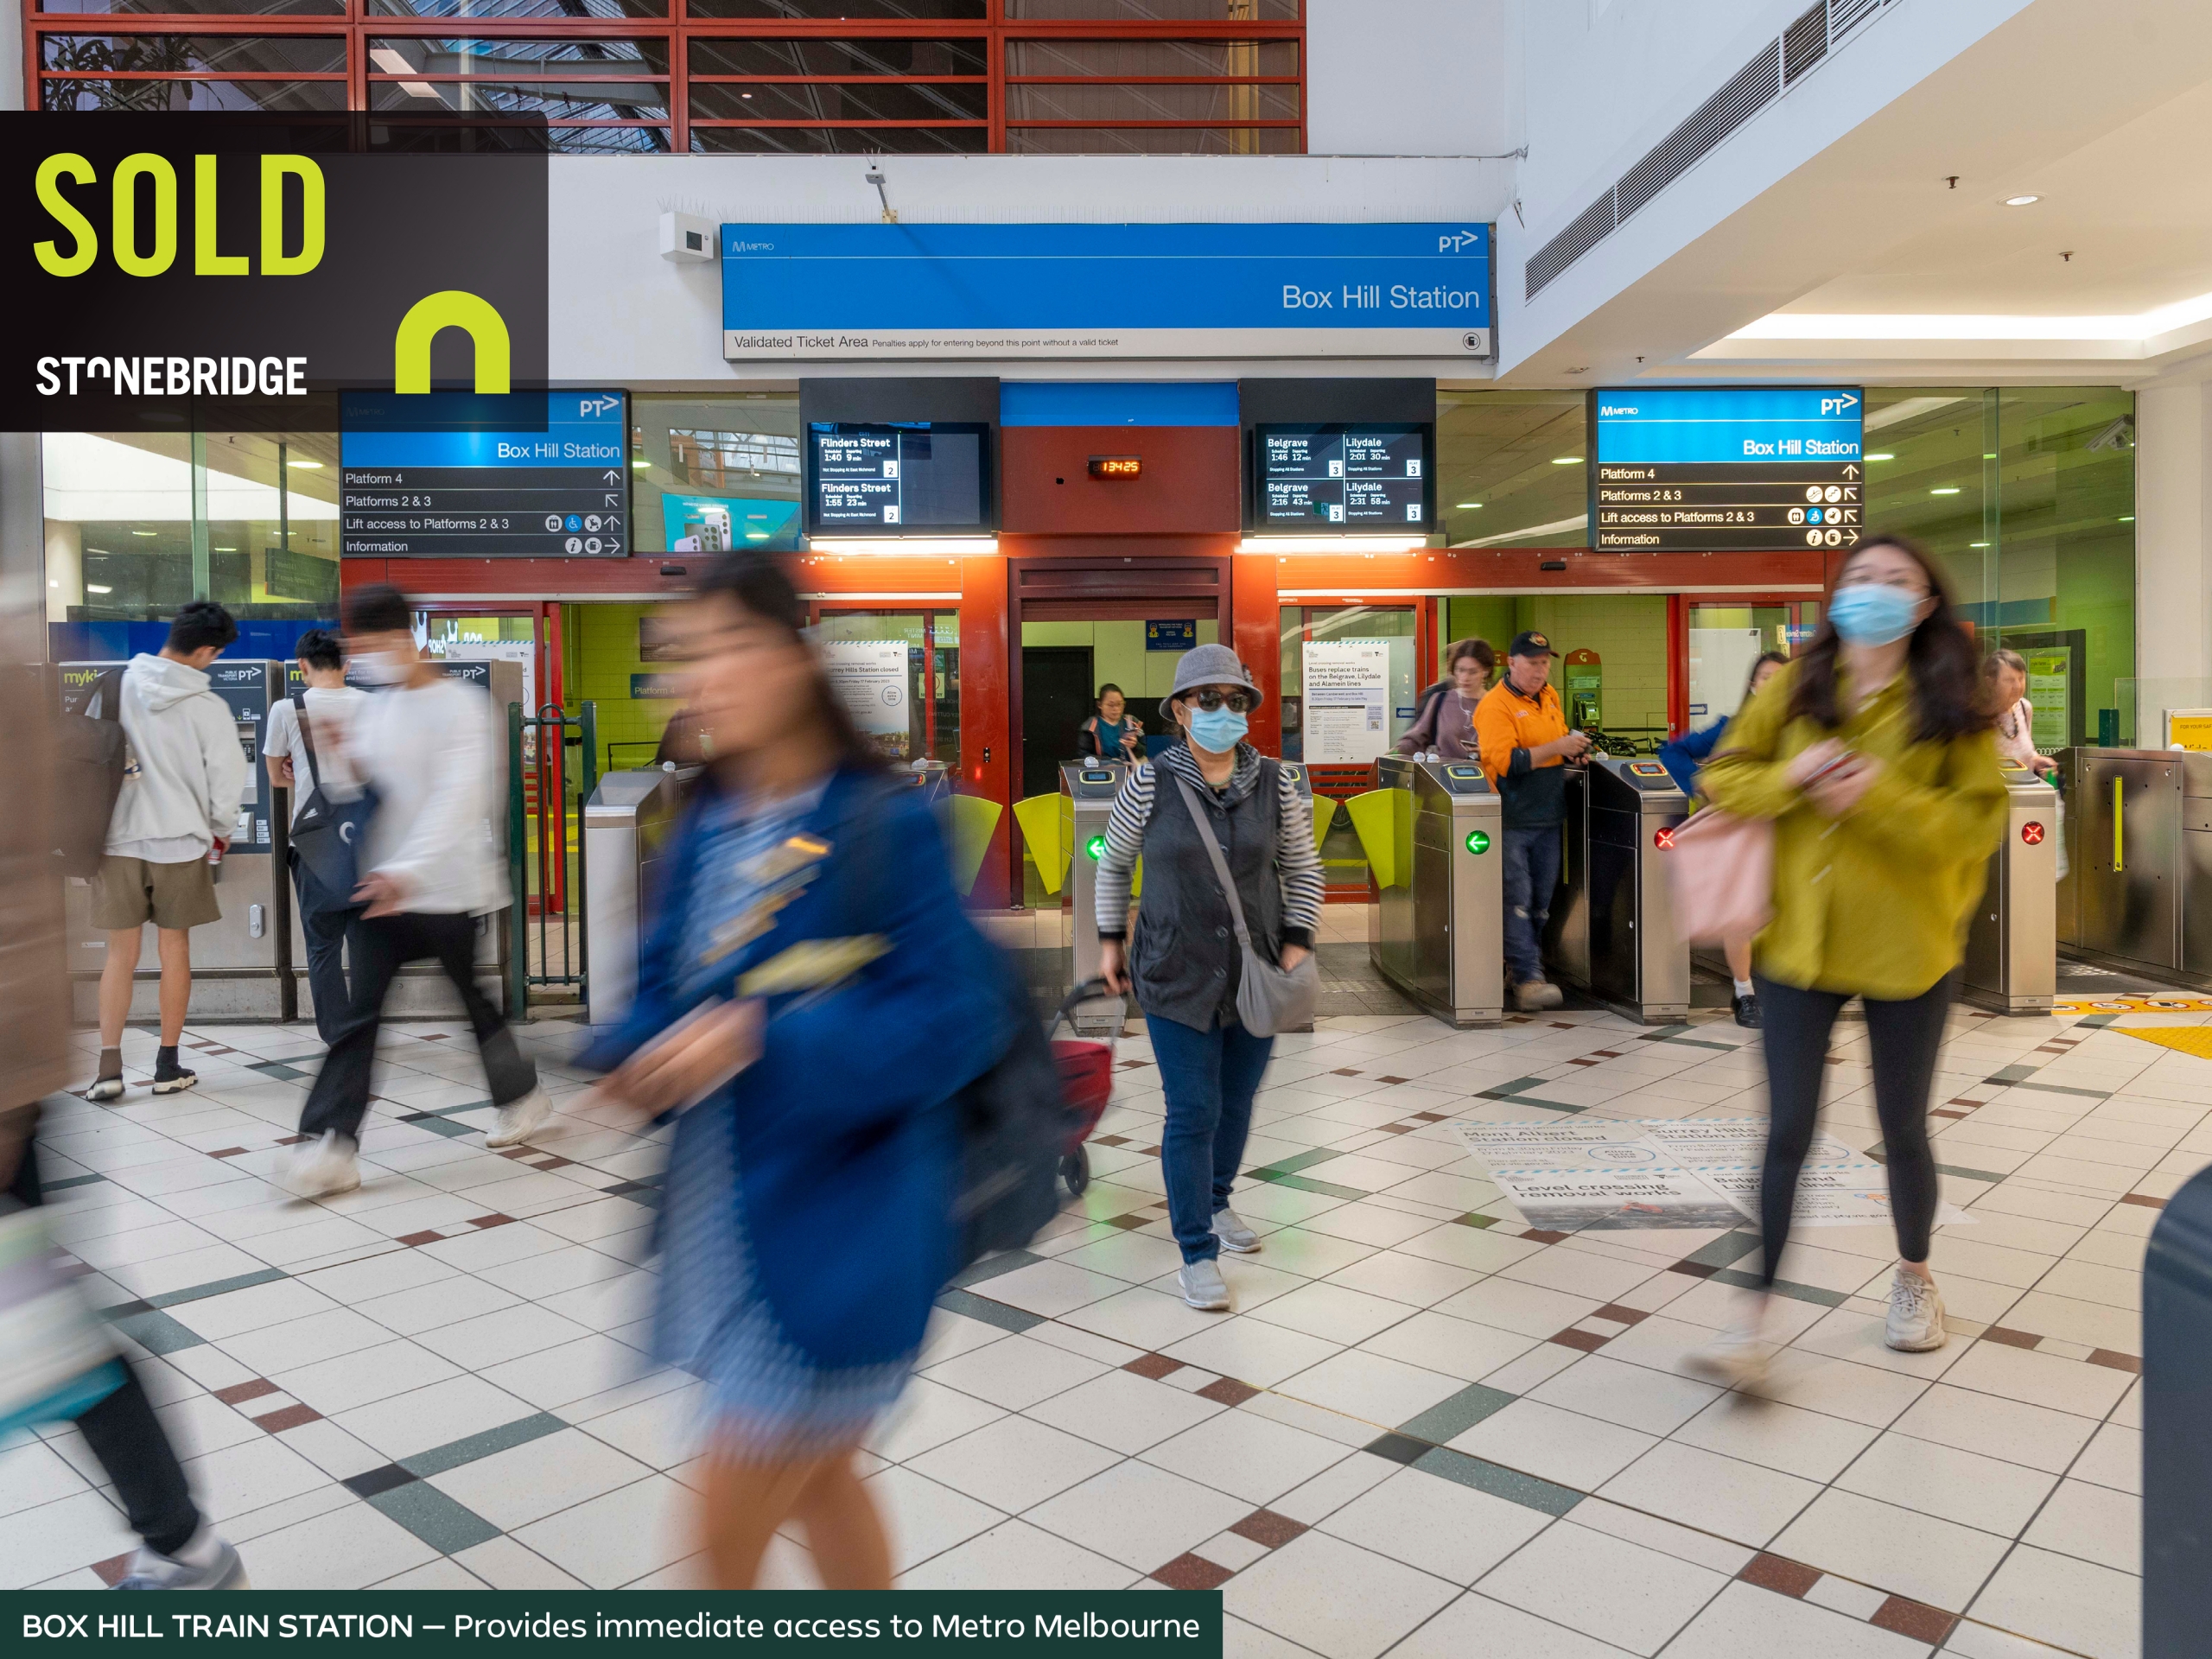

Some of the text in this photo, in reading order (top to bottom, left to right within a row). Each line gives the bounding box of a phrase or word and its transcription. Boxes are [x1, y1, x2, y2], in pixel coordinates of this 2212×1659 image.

[1283, 284, 1480, 308] Box Hill Station
[734, 335, 793, 347] Validated
[797, 335, 835, 347] Ticket
[838, 335, 869, 347] Area
[872, 339, 906, 347] Penalties
[908, 340, 929, 350] apply
[931, 339, 942, 347] for
[944, 339, 974, 349] entering
[976, 339, 1004, 349] beyond
[1021, 339, 1040, 348] point
[1613, 407, 1639, 416] METRO
[821, 438, 891, 447] Flinders Street
[1268, 438, 1308, 448] Belgrave
[1345, 438, 1382, 448] Lilydale
[1743, 439, 1859, 455] Box Hill Station
[498, 442, 620, 458] Box Hill Station
[346, 474, 403, 485] Platform 4
[1601, 468, 1655, 480] Platform 4
[822, 484, 891, 493] Flinders Street
[1268, 484, 1308, 493] Belgrave
[1346, 483, 1382, 493] Lilydale
[1601, 490, 1681, 501] Platforms 2 & 3
[346, 496, 431, 507] Platforms 2 & 3
[1601, 512, 1754, 524] Lift access to Platforms 2 & 3
[346, 518, 509, 530] Lift access to Platforms 2 & 3
[1601, 534, 1659, 545] Information
[346, 541, 408, 552] Information
